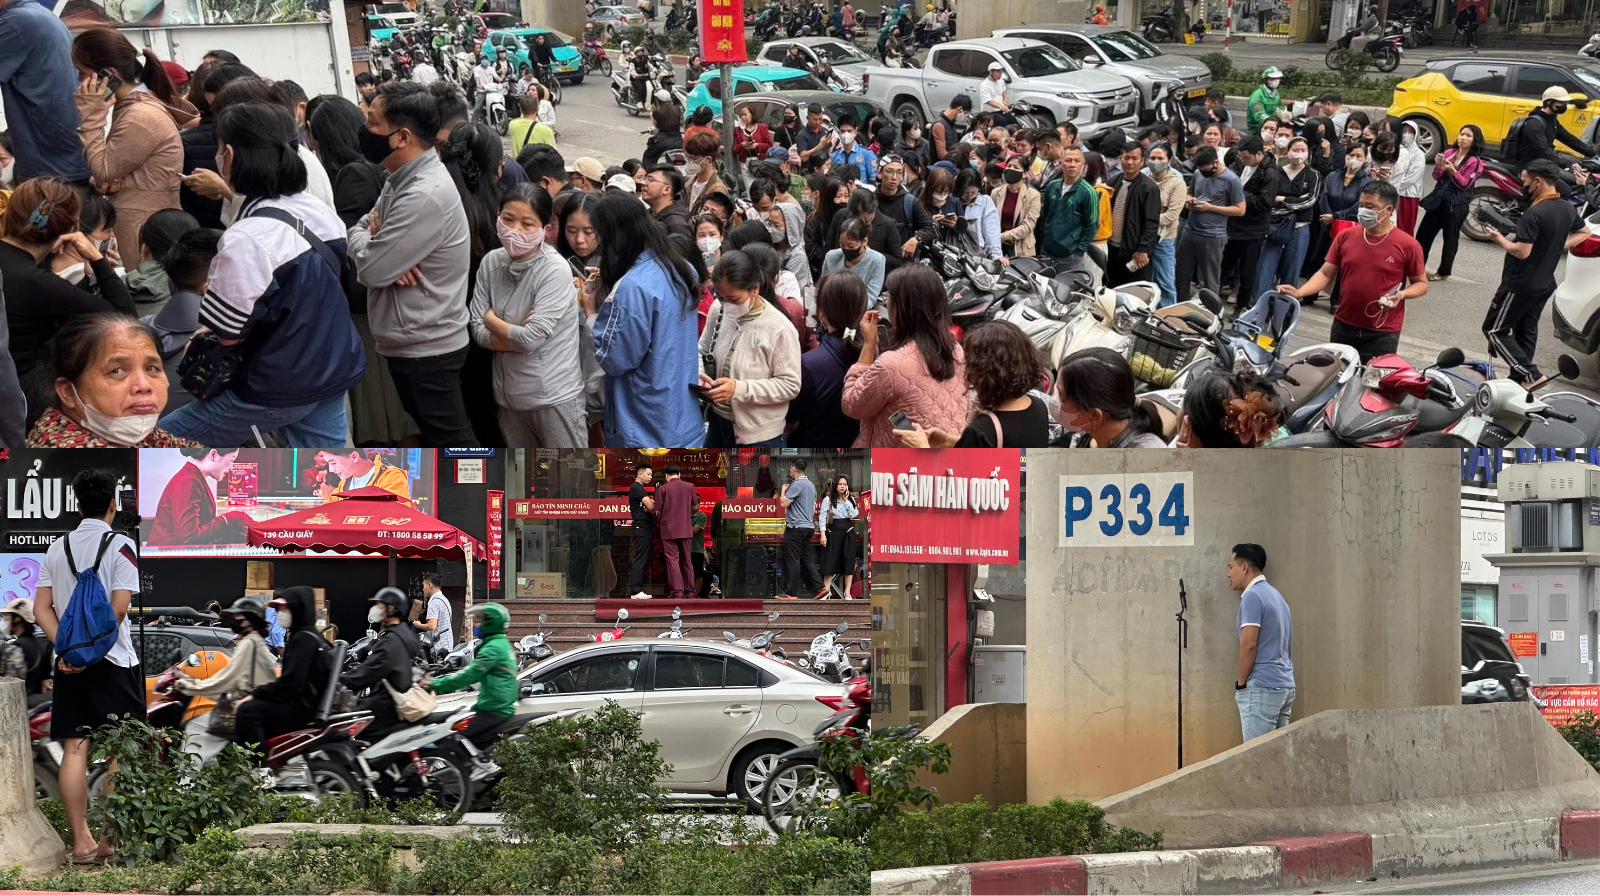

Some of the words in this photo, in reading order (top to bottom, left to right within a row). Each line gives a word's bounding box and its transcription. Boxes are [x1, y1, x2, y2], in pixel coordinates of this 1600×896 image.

[169, 9, 196, 24] SA
[207, 9, 235, 24] PA
[7, 458, 62, 519] LẨU
[896, 466, 934, 508] SÂM
[934, 468, 968, 510] HÀN
[969, 466, 1010, 514] QUỐC
[574, 501, 591, 509] CHÂU
[743, 502, 764, 513] QUÝ
[1065, 482, 1190, 538] P334
[263, 531, 277, 539] 139
[278, 529, 295, 539] CẦU
[296, 529, 314, 539] GIẤY
[377, 530, 390, 538] ĐT:
[392, 531, 411, 539] 1800
[412, 531, 422, 539] 58
[434, 532, 444, 540] 99
[1472, 531, 1498, 542] LOTOS
[9, 535, 57, 545] HOTLINE
[1563, 697, 1576, 707] CẤM
[1587, 698, 1599, 707] RÁC
